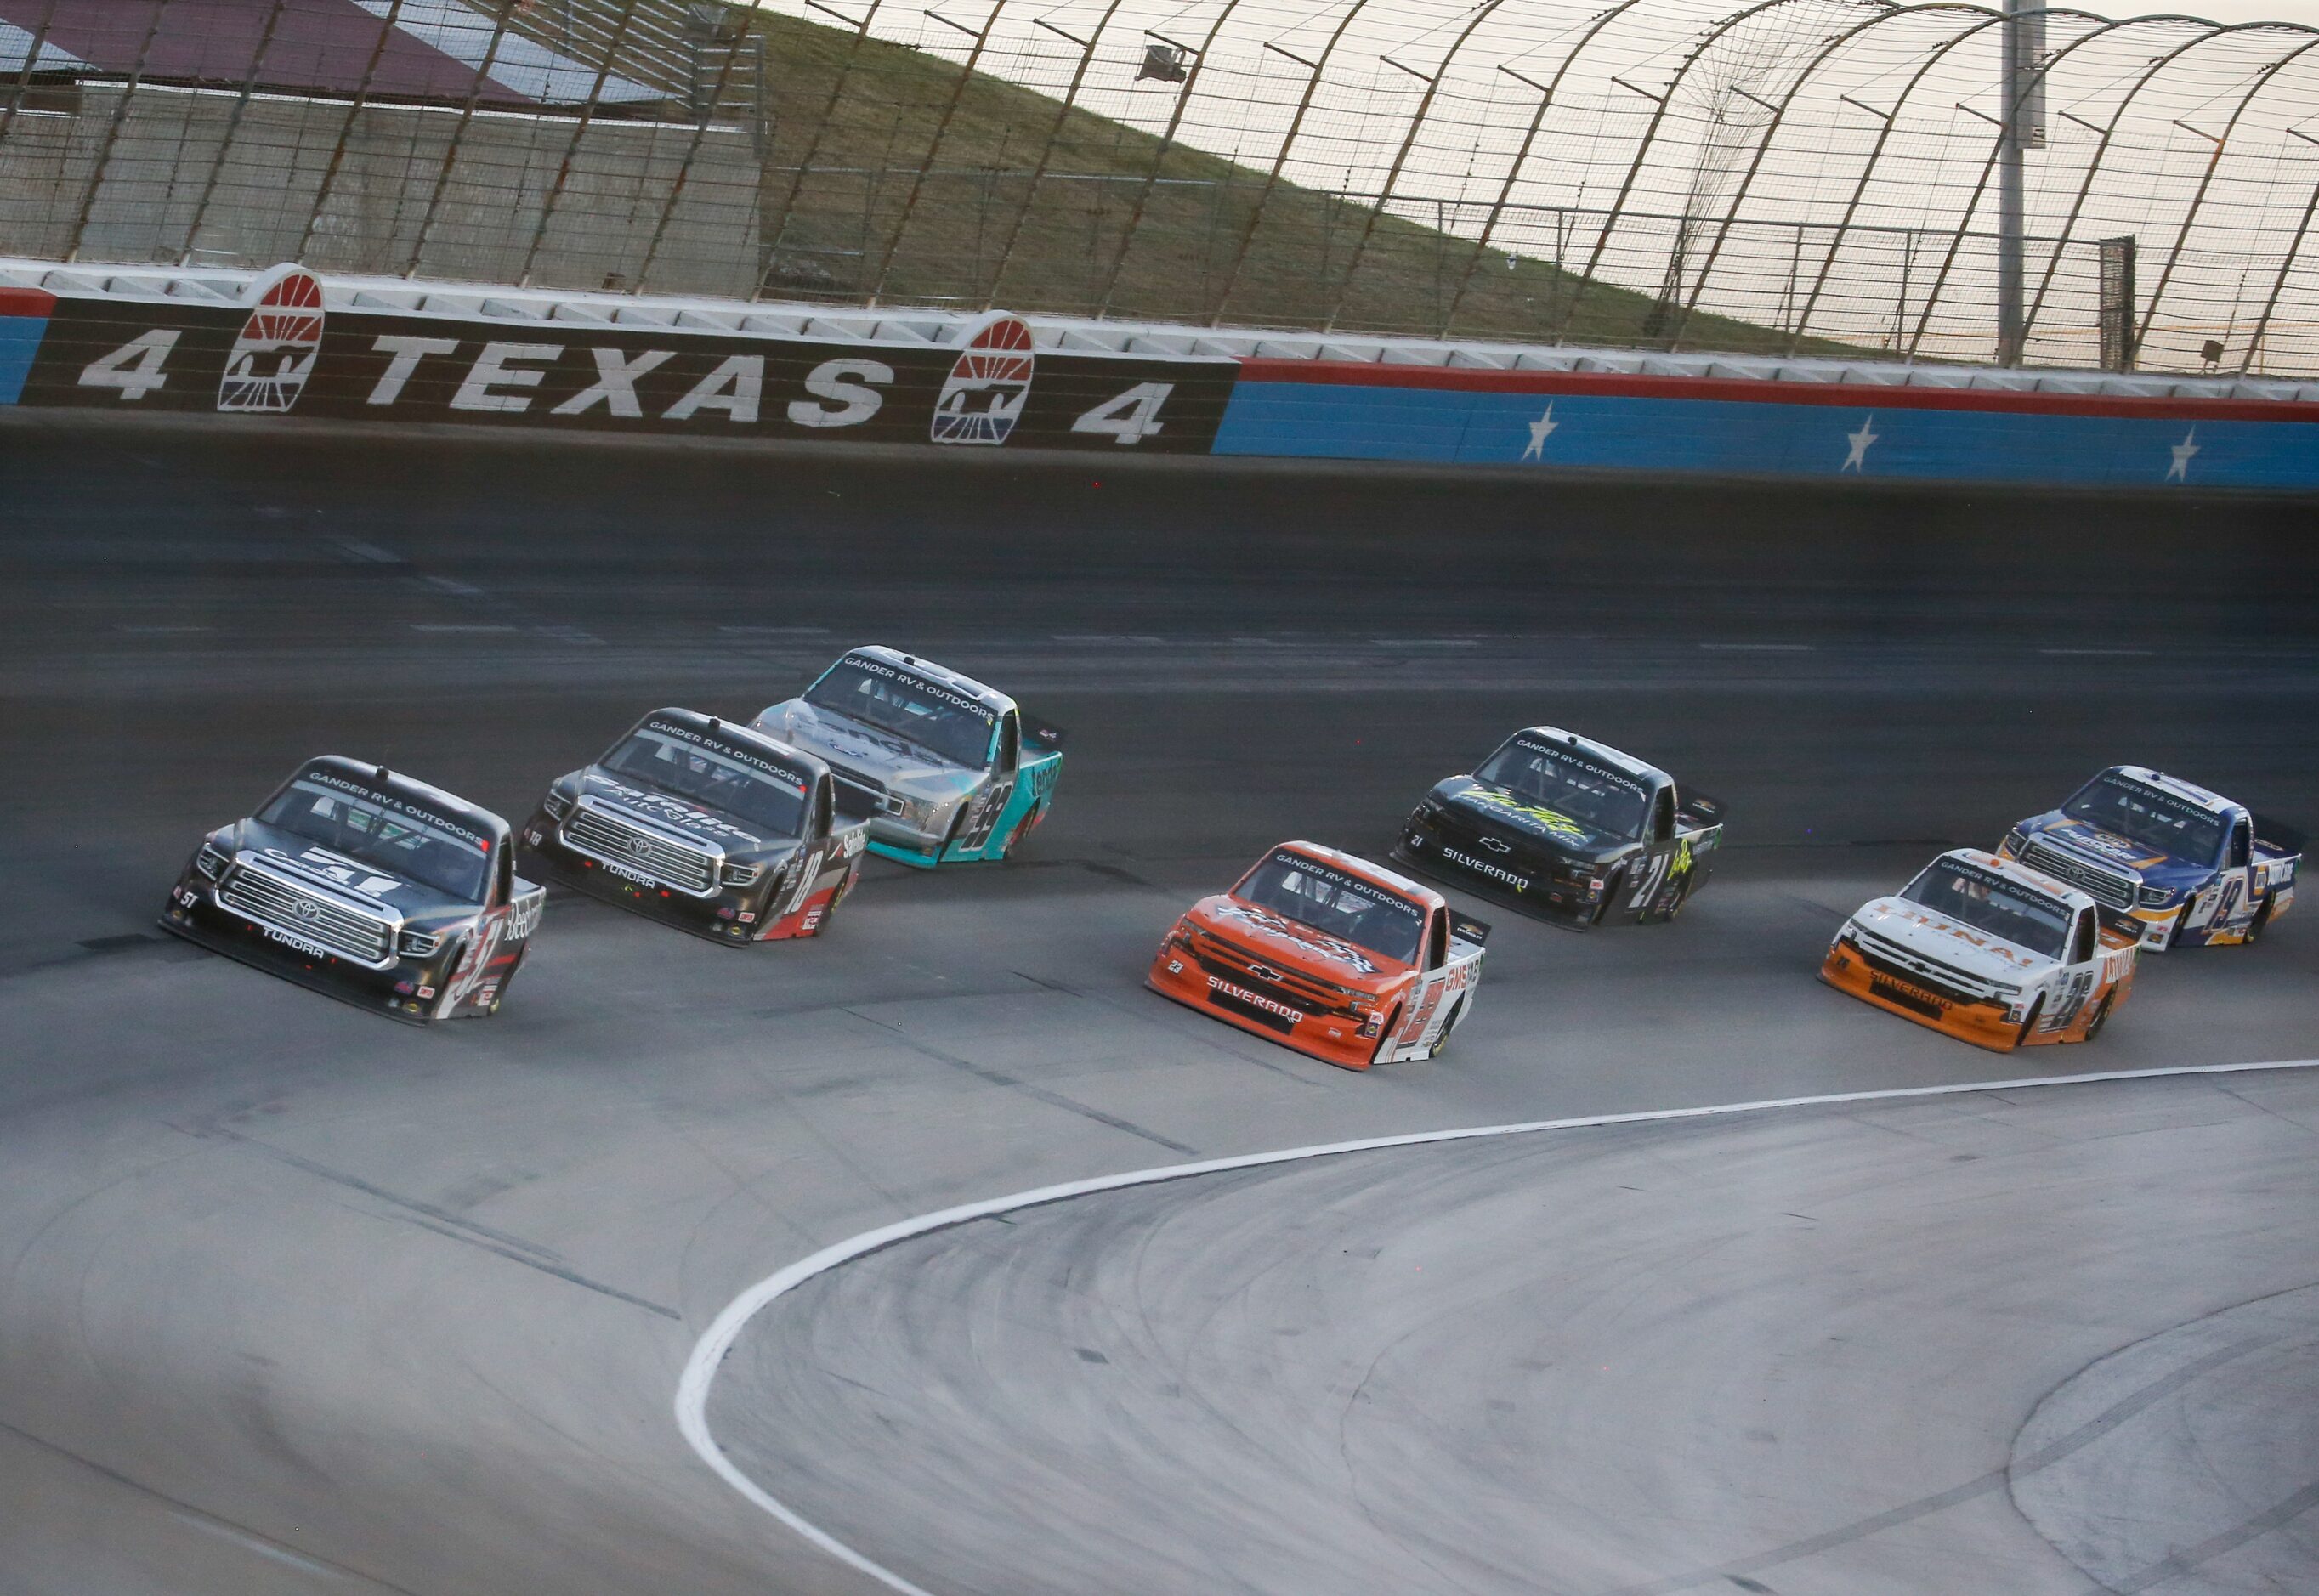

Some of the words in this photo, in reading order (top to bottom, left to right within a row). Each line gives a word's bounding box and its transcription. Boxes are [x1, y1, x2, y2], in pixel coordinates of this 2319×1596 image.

[77, 329, 182, 399] 4
[366, 335, 893, 427] TEXAS
[1070, 382, 1175, 444] 4
[844, 657, 895, 678] GANDER
[897, 674, 916, 686] RV
[916, 682, 925, 690] &
[927, 686, 995, 721] OUTDOORS
[649, 722, 702, 743] GANDER
[704, 739, 723, 750] RV
[723, 746, 731, 755] &
[734, 750, 803, 786] OUTDOORS
[1517, 739, 1560, 758] GANDER
[1561, 754, 1578, 764] RV
[1585, 764, 1644, 793] OUTDOORS
[309, 773, 369, 796] GANDER
[371, 792, 394, 805] RV
[393, 801, 403, 810] &
[405, 806, 483, 846] OUTDOORS
[2103, 777, 2142, 794] GANDER
[2143, 790, 2158, 799] RV
[2166, 799, 2220, 827] OUTDOORS
[1410, 835, 1424, 847] 21
[1443, 847, 1528, 889] SILVERADO
[180, 891, 199, 908] 51
[600, 860, 655, 890] TUNDRA
[783, 850, 824, 914] 18
[1276, 854, 1324, 875] GANDER
[1325, 871, 1345, 882] RV
[1353, 883, 1419, 917] OUTDOORS
[1628, 853, 1669, 908] 21
[1941, 861, 1982, 880] GANDER
[1984, 876, 1999, 886] RV
[2008, 886, 2067, 916] OUTDOORS
[263, 926, 324, 959] TUNDRA
[1167, 960, 1184, 975] 23
[1207, 976, 1303, 1023] SILVERADO
[1870, 970, 1953, 1010] SILVERADO
